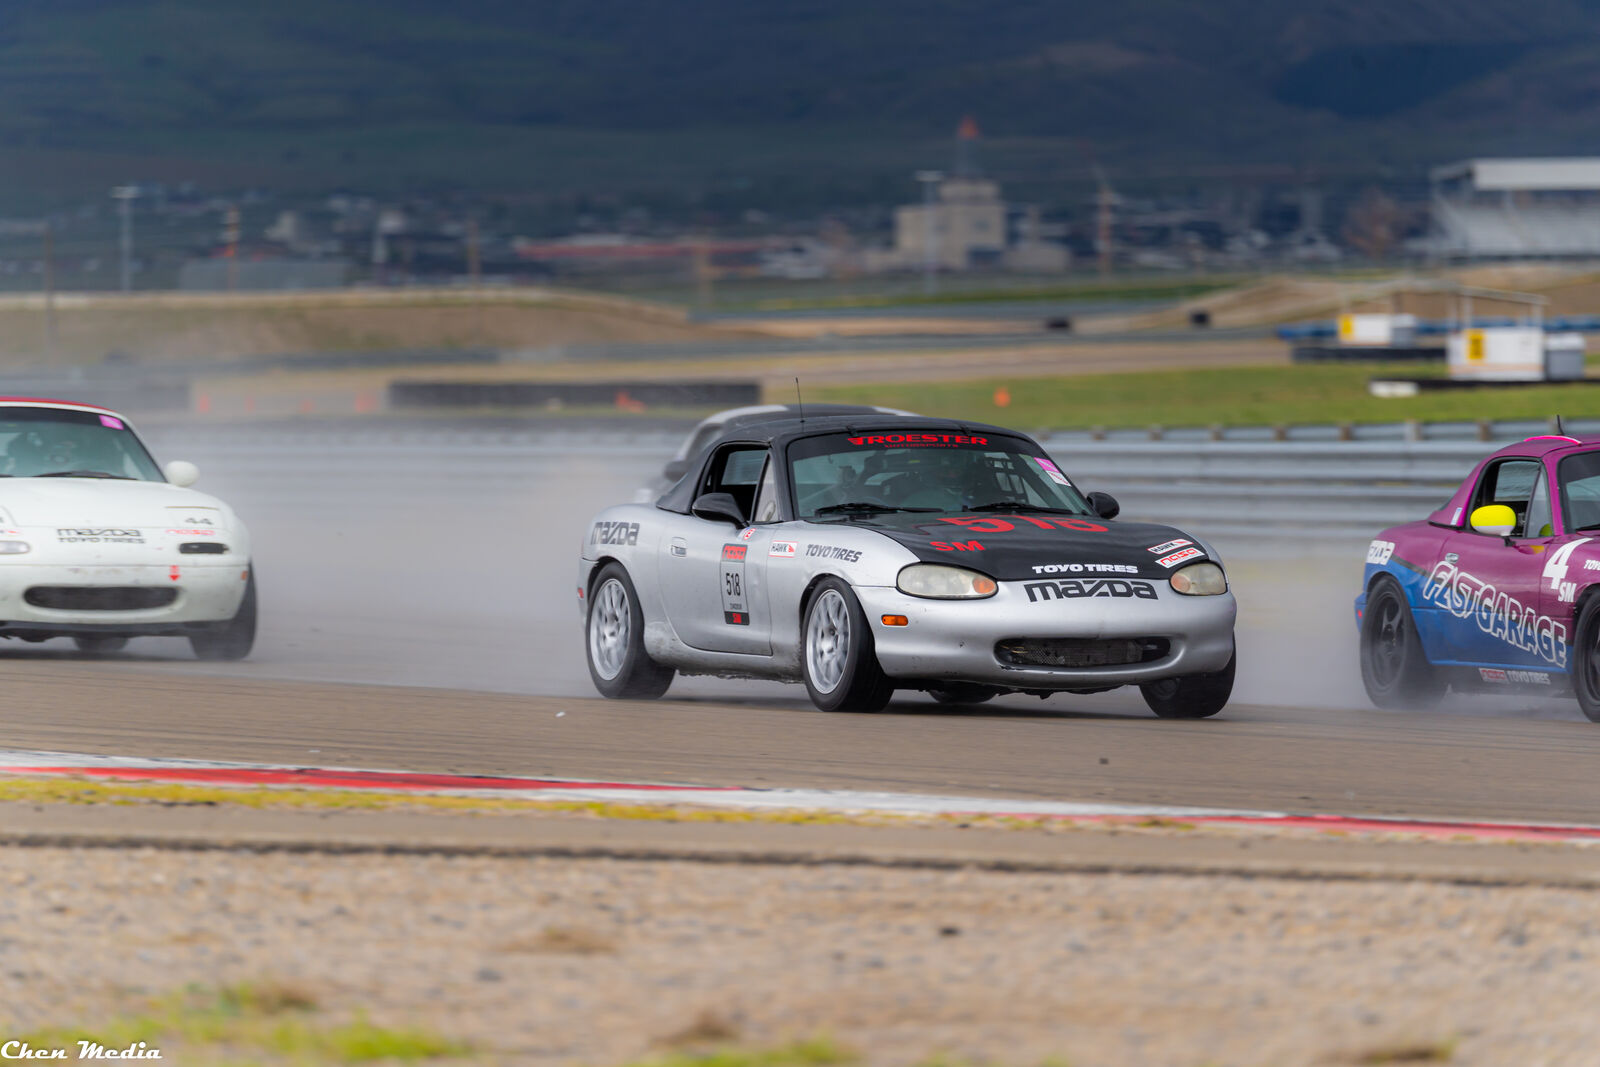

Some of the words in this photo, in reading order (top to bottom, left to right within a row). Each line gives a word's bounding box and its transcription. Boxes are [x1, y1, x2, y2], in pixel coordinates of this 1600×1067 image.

[848, 434, 987, 445] TROESTER
[936, 514, 1109, 533] 518
[929, 540, 986, 551] SM
[1032, 564, 1083, 574] TOYO
[1084, 564, 1138, 574] TIRES
[1542, 537, 1594, 590] 4
[726, 573, 741, 596] 518
[1558, 582, 1577, 602] SM
